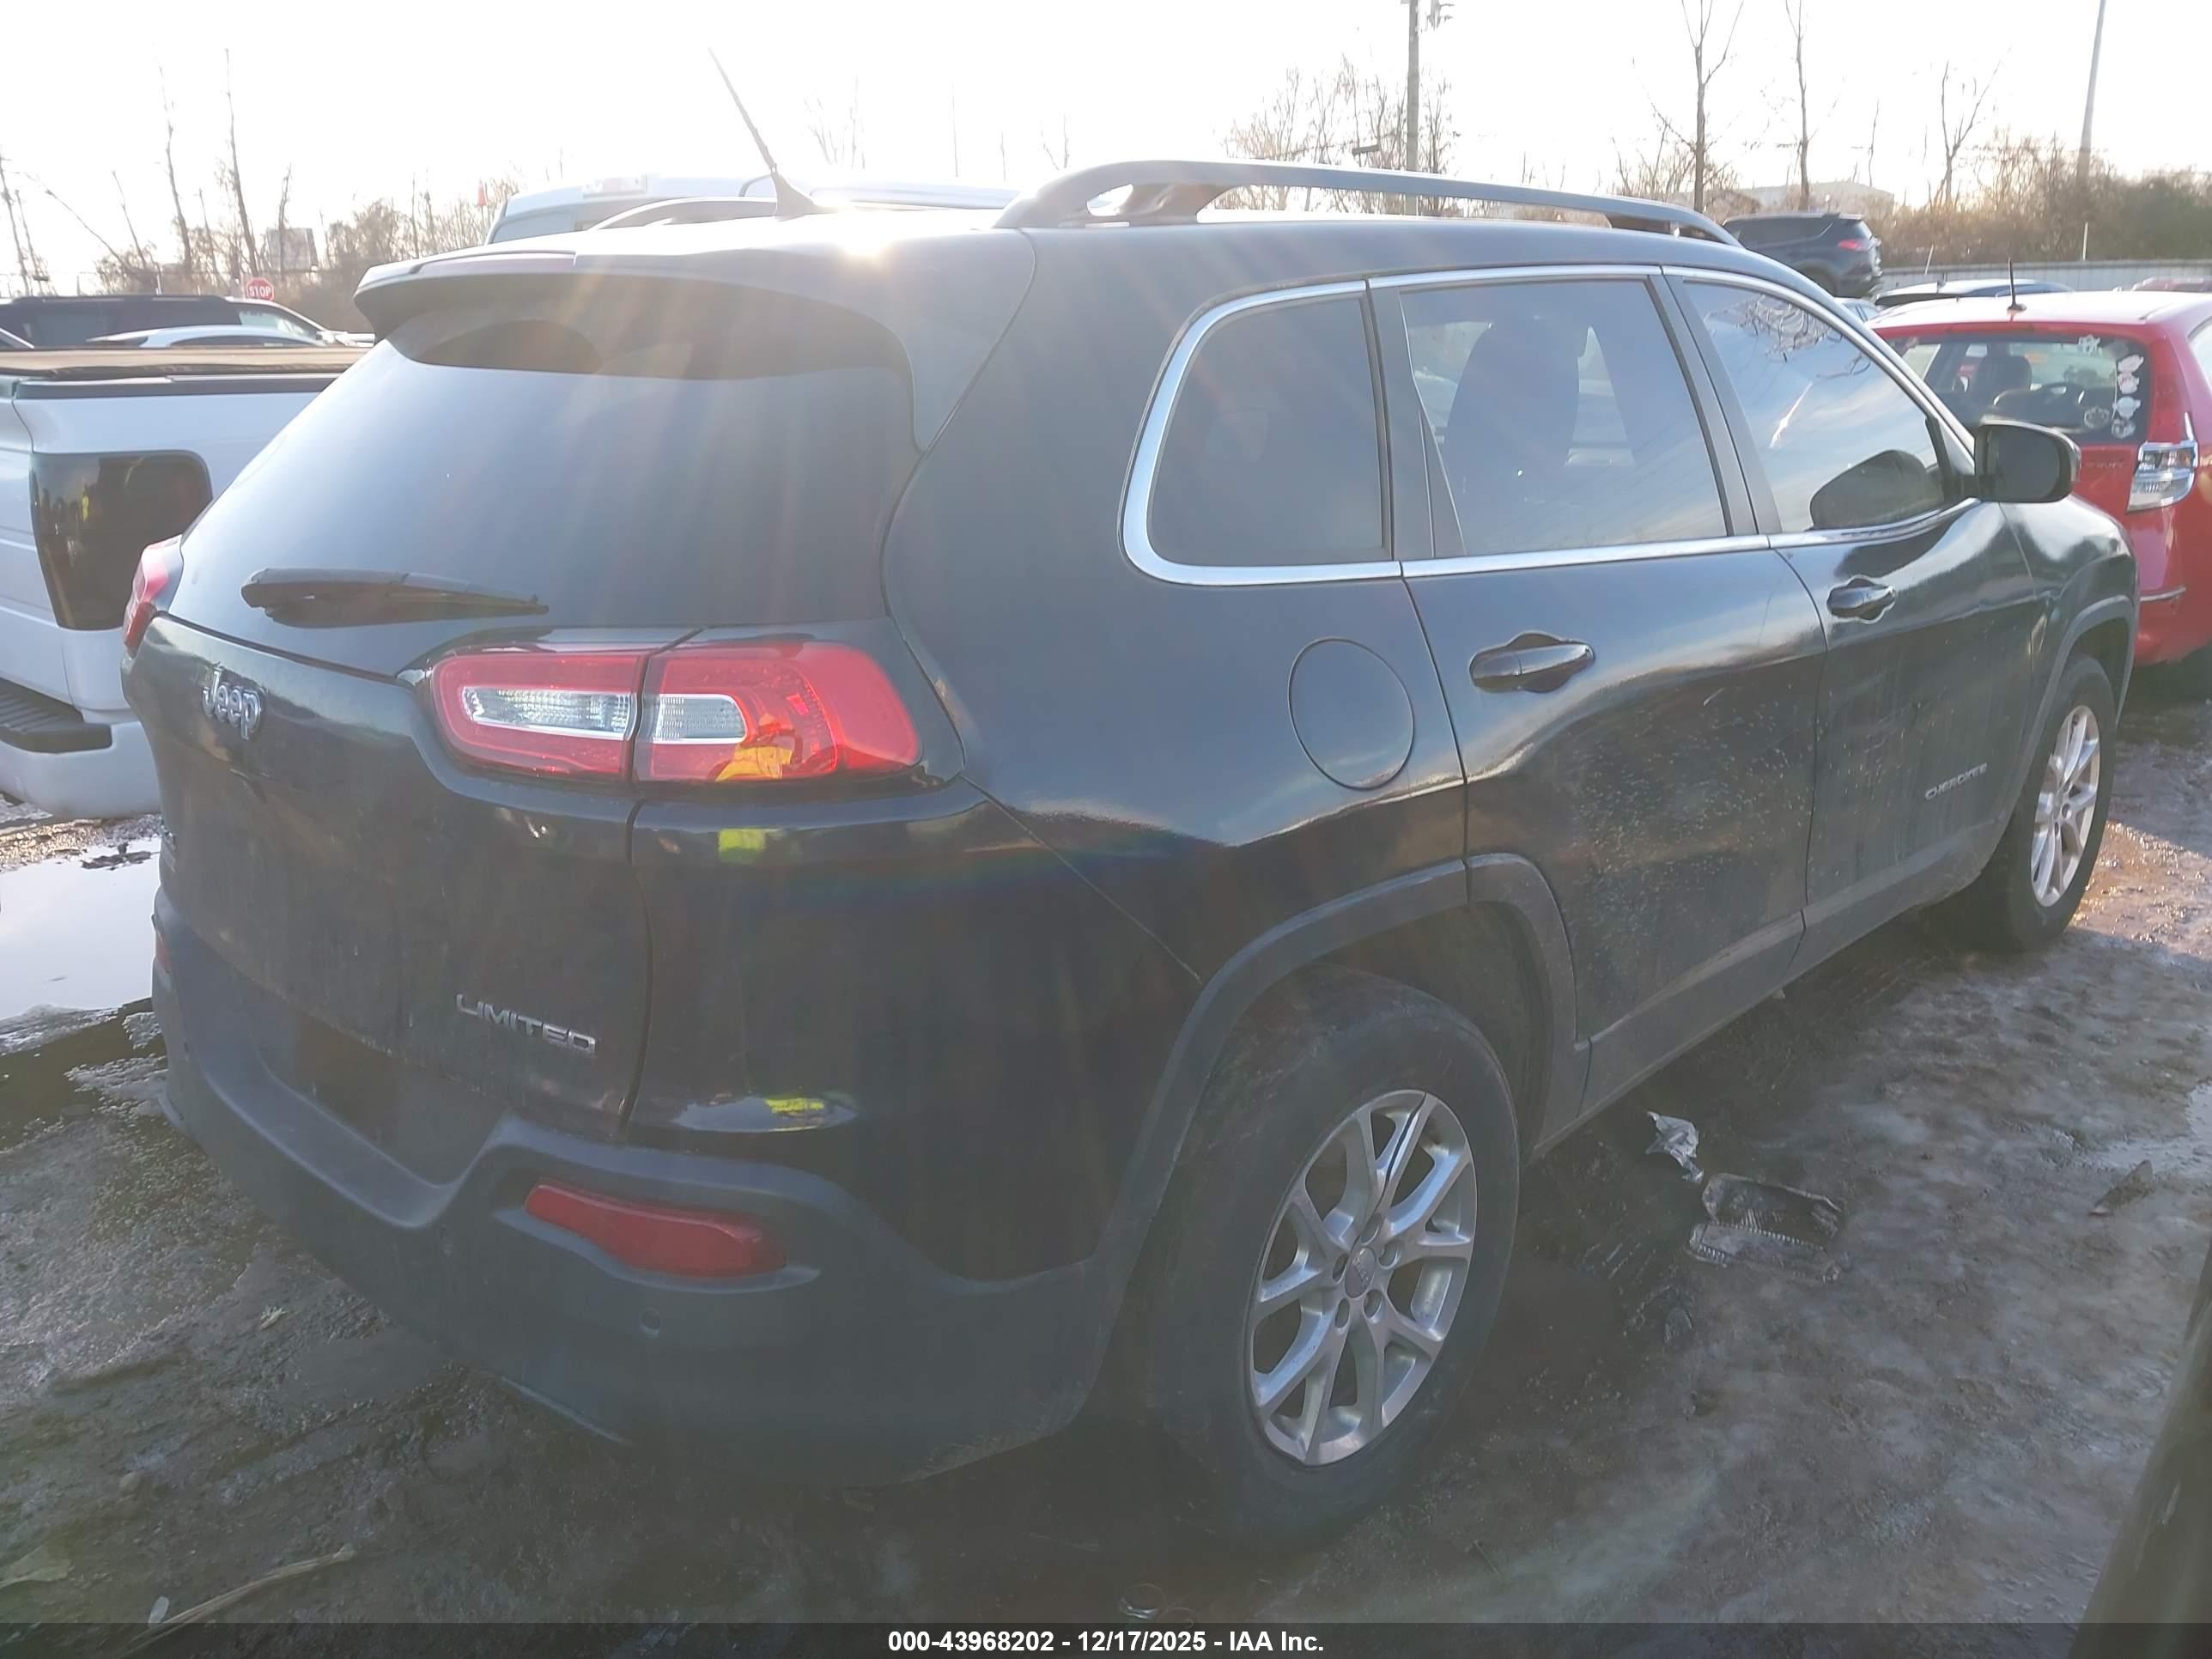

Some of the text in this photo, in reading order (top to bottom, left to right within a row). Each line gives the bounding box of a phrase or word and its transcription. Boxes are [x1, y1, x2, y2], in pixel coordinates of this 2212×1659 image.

[249, 285, 271, 297] STOP
[202, 665, 262, 740] Jeep
[456, 994, 597, 1056] LIMITED
